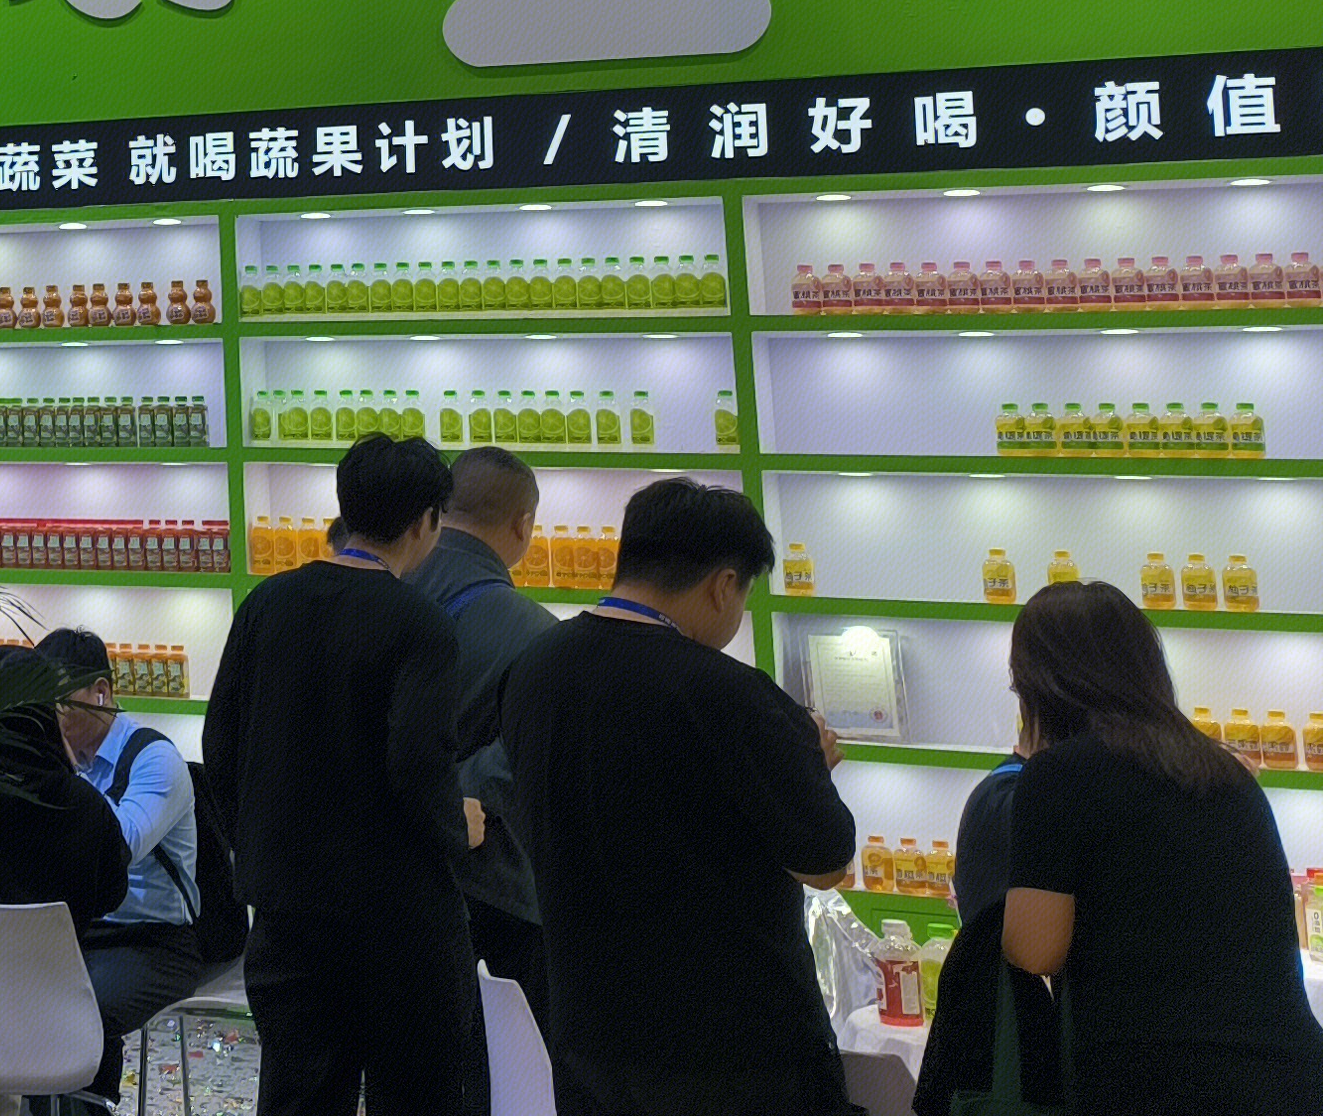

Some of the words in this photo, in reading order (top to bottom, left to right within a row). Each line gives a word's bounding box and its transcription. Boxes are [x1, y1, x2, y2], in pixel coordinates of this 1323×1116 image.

[128, 116, 494, 187] 就喝蔬果计划
